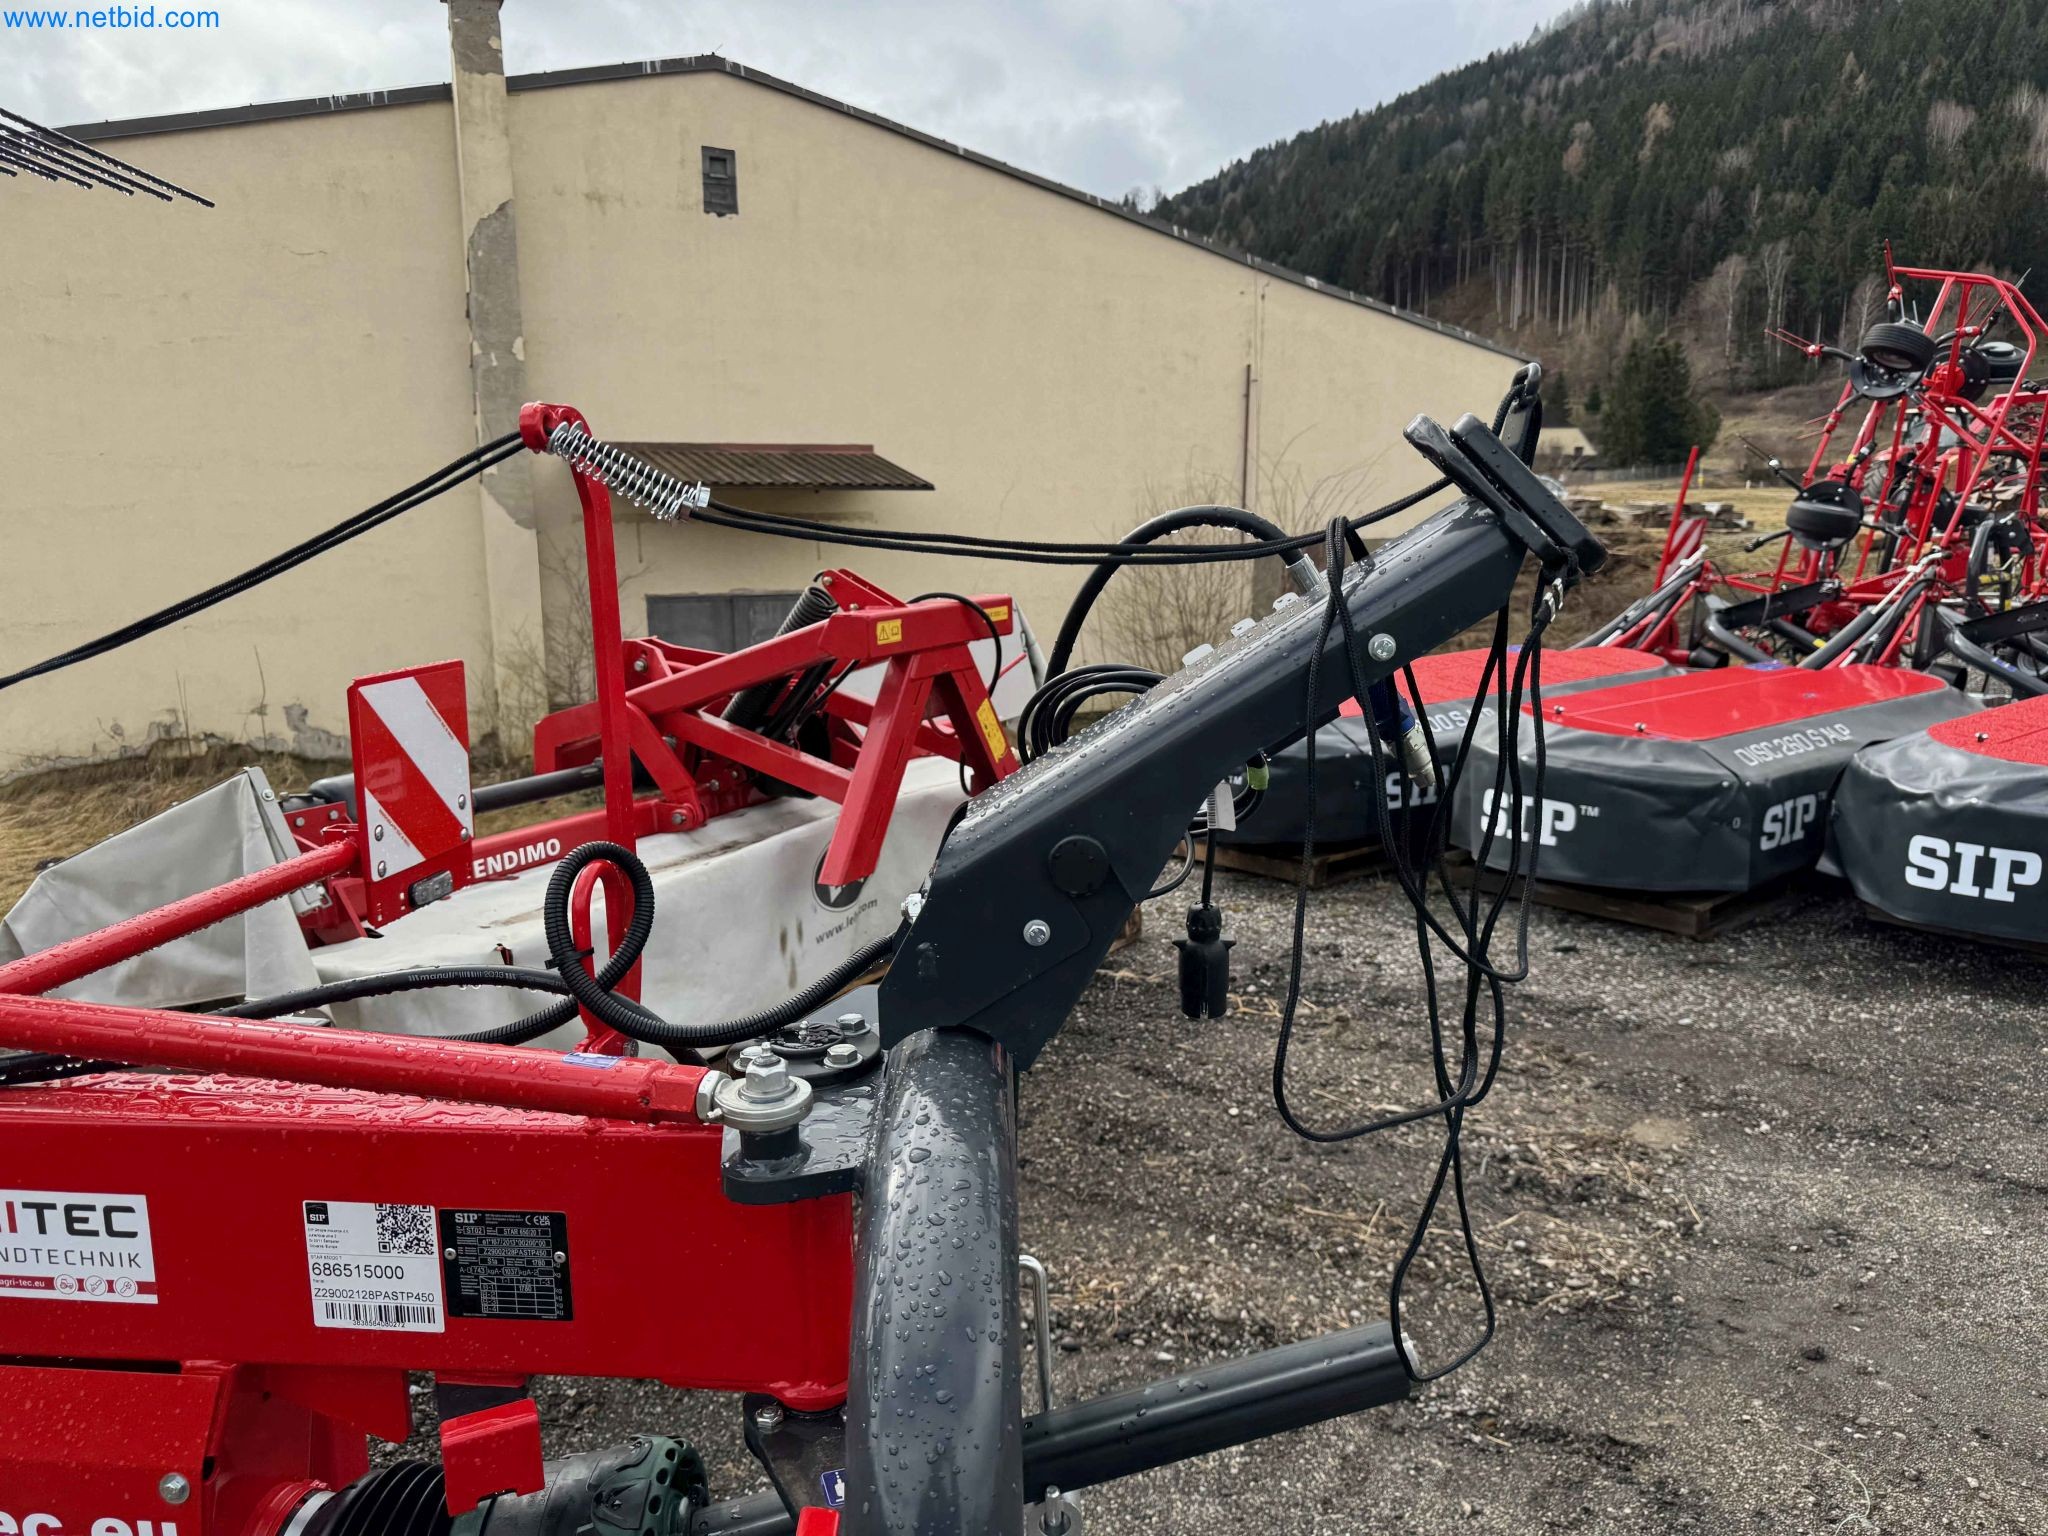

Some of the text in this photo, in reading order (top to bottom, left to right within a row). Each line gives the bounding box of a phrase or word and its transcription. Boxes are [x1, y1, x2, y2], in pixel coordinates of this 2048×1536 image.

[1733, 742, 1774, 766] DISC
[1773, 732, 1814, 757] 260
[1806, 729, 1828, 748] S
[1480, 788, 1577, 846] SIP
[1760, 794, 1817, 851] SIP
[472, 838, 561, 879] ENDIMO
[1905, 834, 2043, 903] SIP
[0, 1201, 139, 1239] ITEC
[309, 1214, 326, 1222] SIP
[454, 1213, 478, 1224] SIP
[312, 1262, 404, 1279] 686515000
[314, 1287, 435, 1302] Z29002128PASTP450
